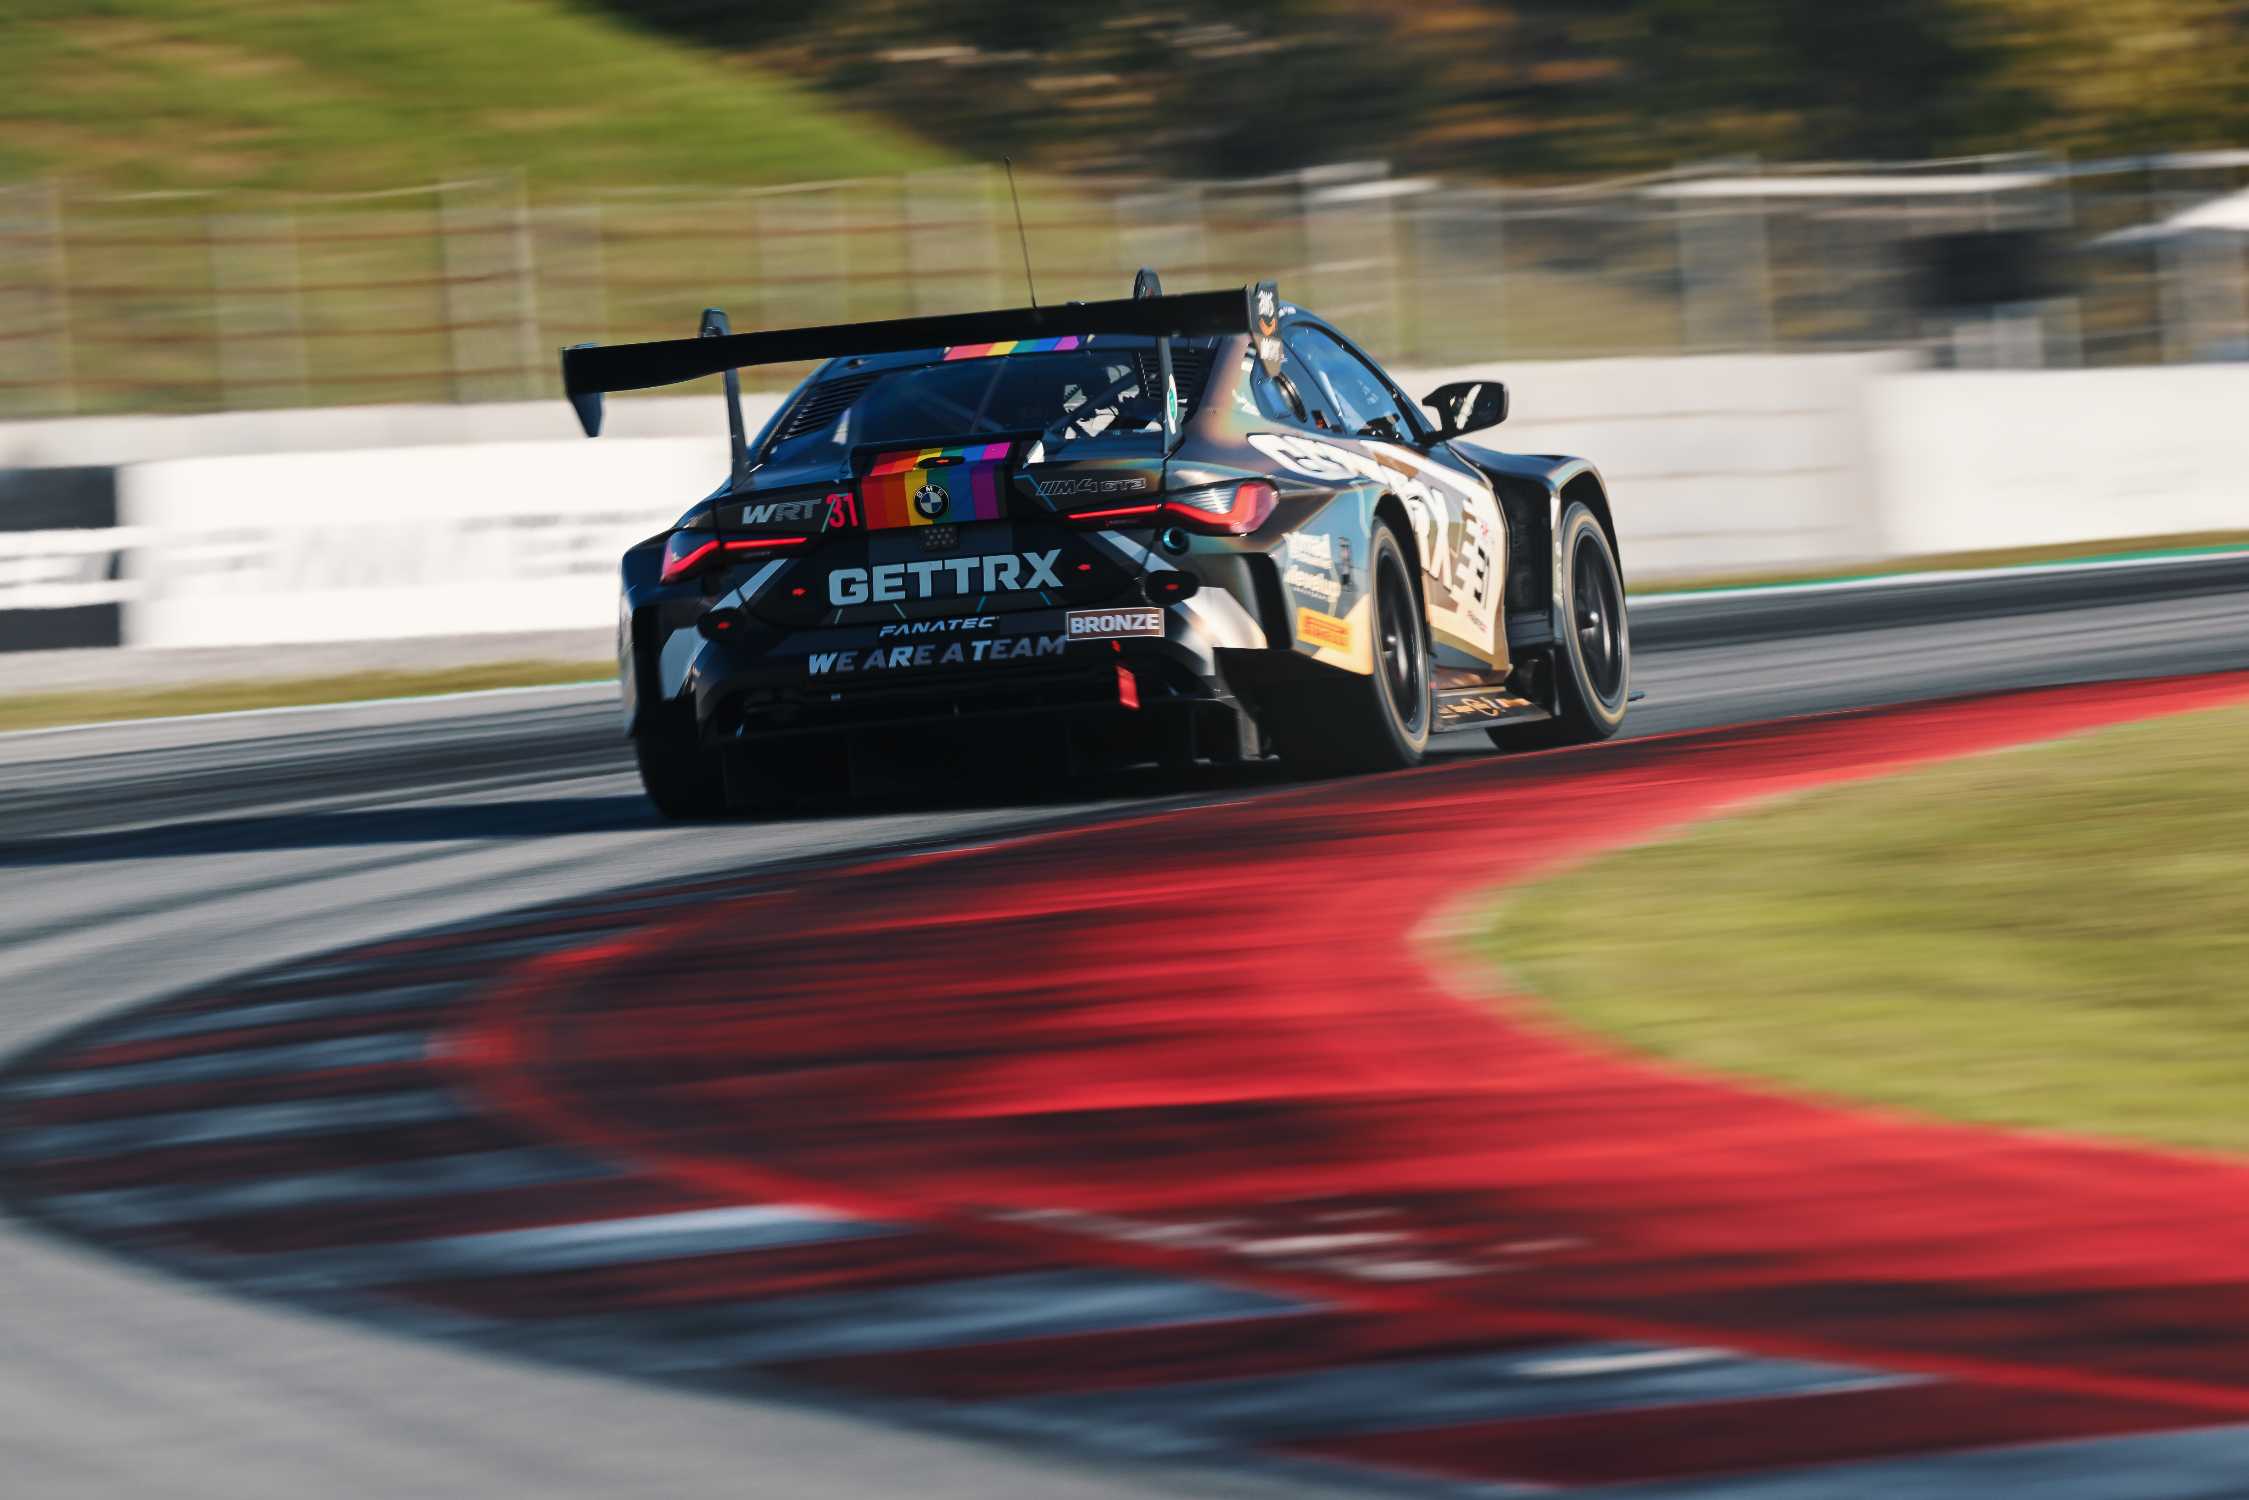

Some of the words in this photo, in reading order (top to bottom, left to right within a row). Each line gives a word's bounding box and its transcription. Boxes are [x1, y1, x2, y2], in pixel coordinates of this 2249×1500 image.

[1101, 478, 1147, 492] GT3
[742, 498, 822, 525] WRT
[826, 491, 859, 529] 31
[828, 549, 1064, 606] GETTRX
[879, 616, 997, 637] FANATEC
[1069, 613, 1161, 635] BRONZE
[808, 651, 858, 676] WE
[863, 644, 936, 671] ARE
[940, 642, 965, 665] A
[971, 634, 1069, 662] TEAM
